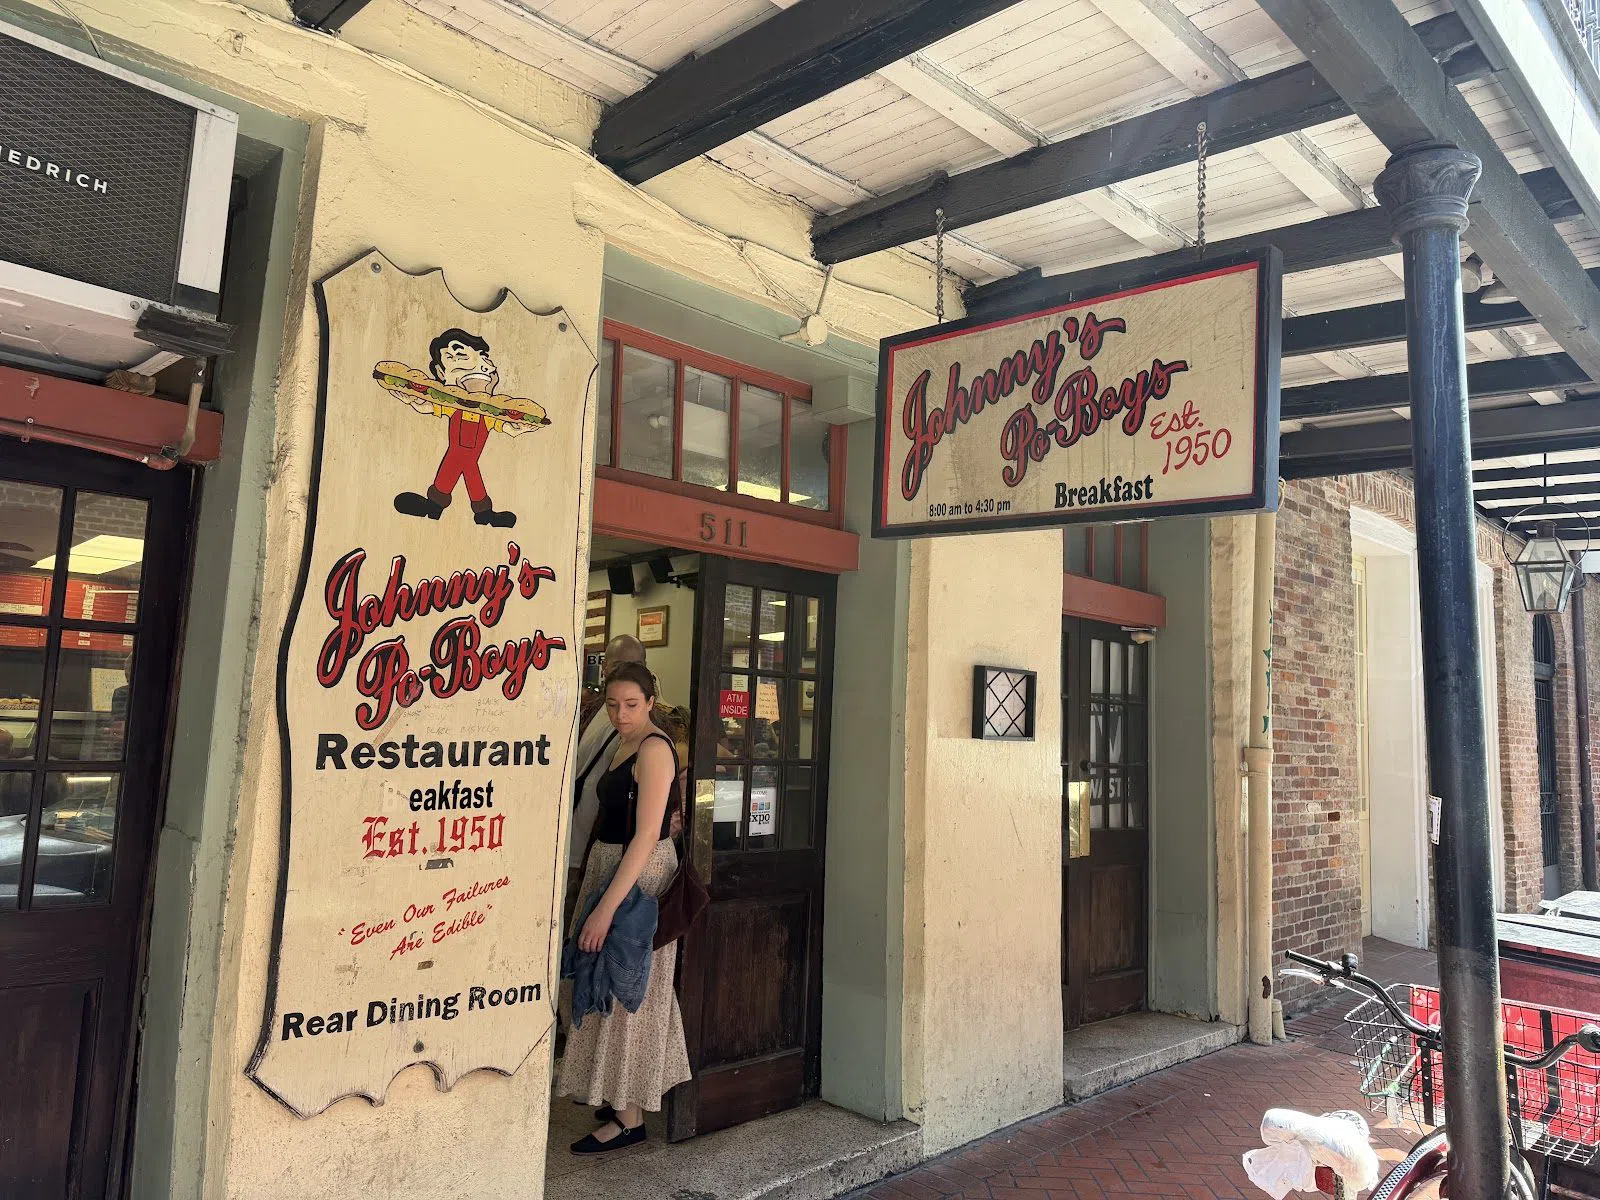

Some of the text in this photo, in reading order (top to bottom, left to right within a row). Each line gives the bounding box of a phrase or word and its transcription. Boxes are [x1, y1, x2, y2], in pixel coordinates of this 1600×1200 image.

[901, 311, 1127, 501] Johnny's
[1000, 357, 1189, 487] Po-Boys
[1149, 400, 1204, 440] Est.
[1162, 428, 1232, 475] 1950
[928, 498, 1011, 517] 8:00 am to 4:30 pm
[1054, 474, 1154, 509] Breakfast
[699, 512, 750, 549] 511
[316, 540, 556, 688] Johnny's
[355, 615, 567, 731] Po-Boys
[720, 704, 748, 715] INSIDE
[726, 693, 744, 703] ATM
[315, 733, 551, 770] Restaurant
[362, 812, 507, 860] Est. 1950
[403, 904, 435, 924] Our
[442, 875, 511, 911] Failures
[390, 936, 424, 960] Are
[281, 982, 542, 1041] Rear Dining Room
